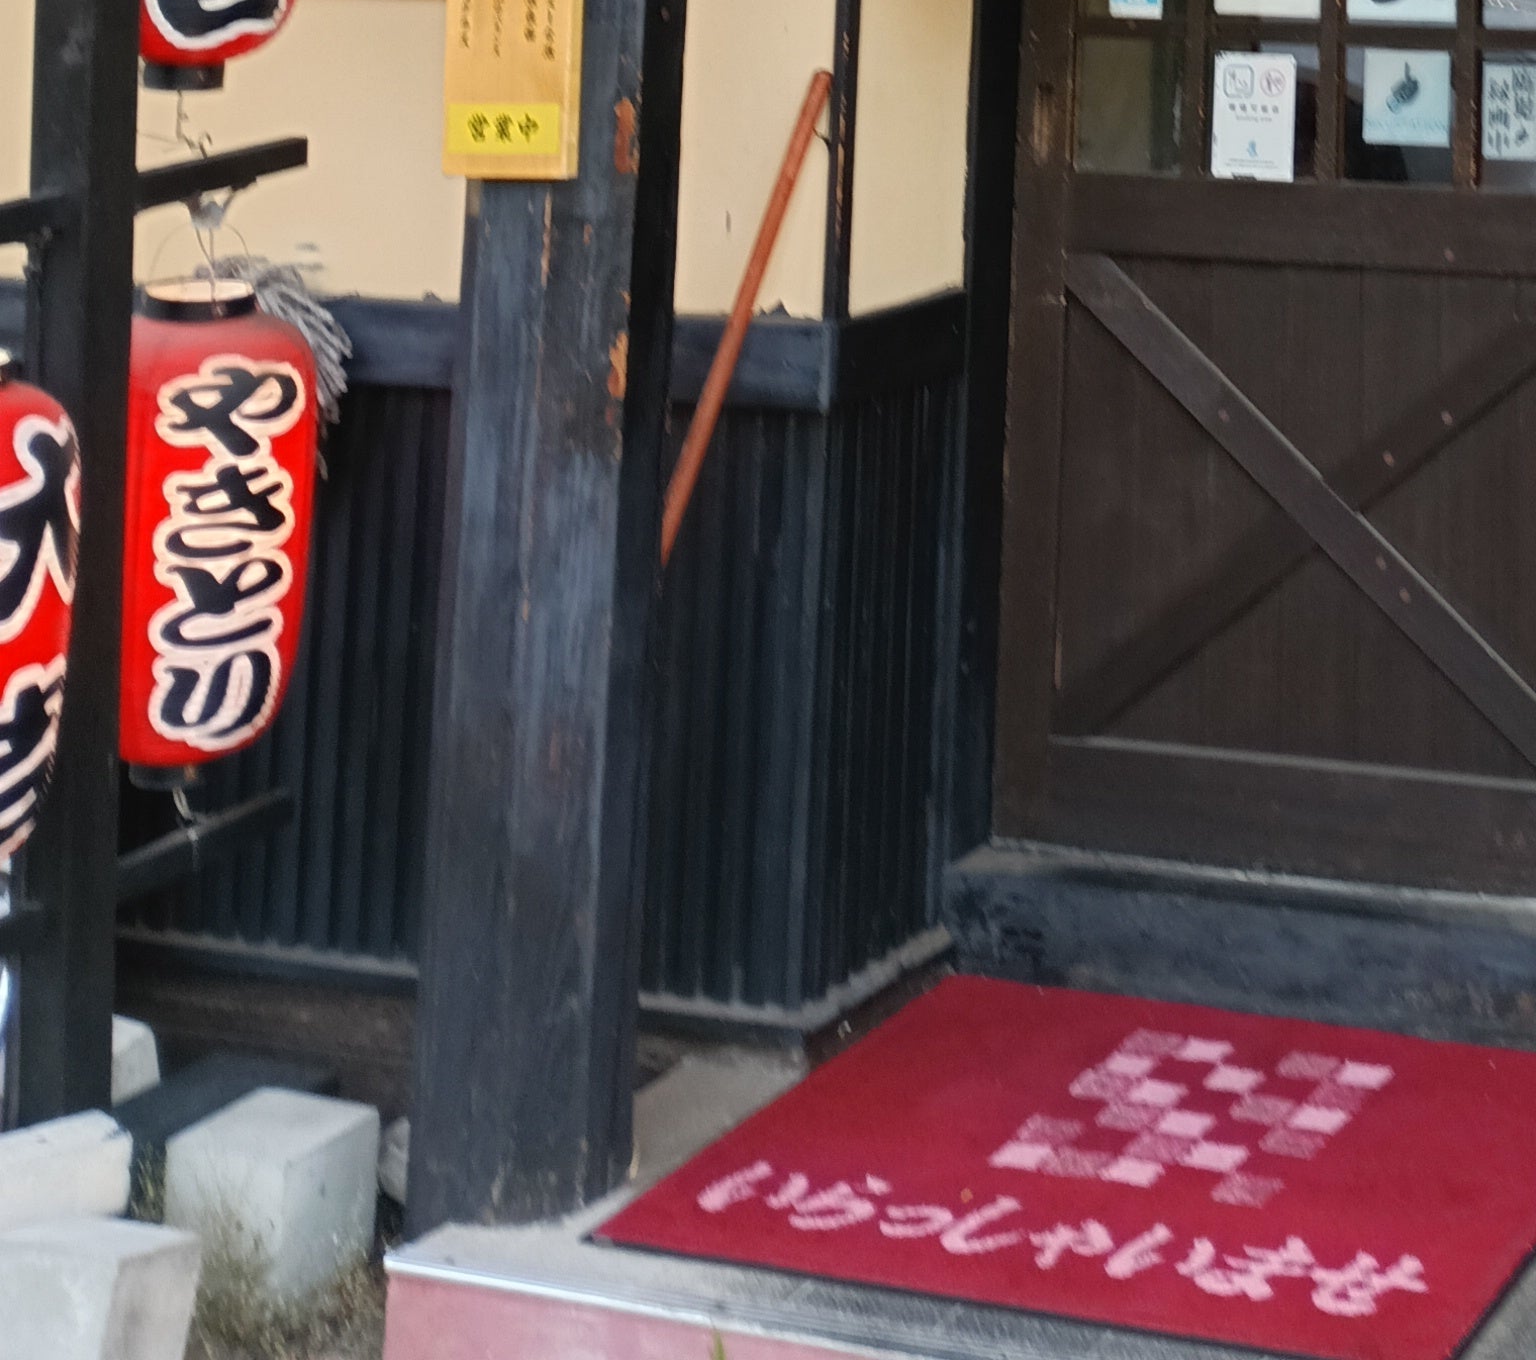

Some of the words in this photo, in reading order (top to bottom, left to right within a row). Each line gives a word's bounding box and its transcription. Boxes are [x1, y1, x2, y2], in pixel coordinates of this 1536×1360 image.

[152, 355, 303, 750] やきとり
[697, 1160, 1428, 1318] いらっしゃいませ
